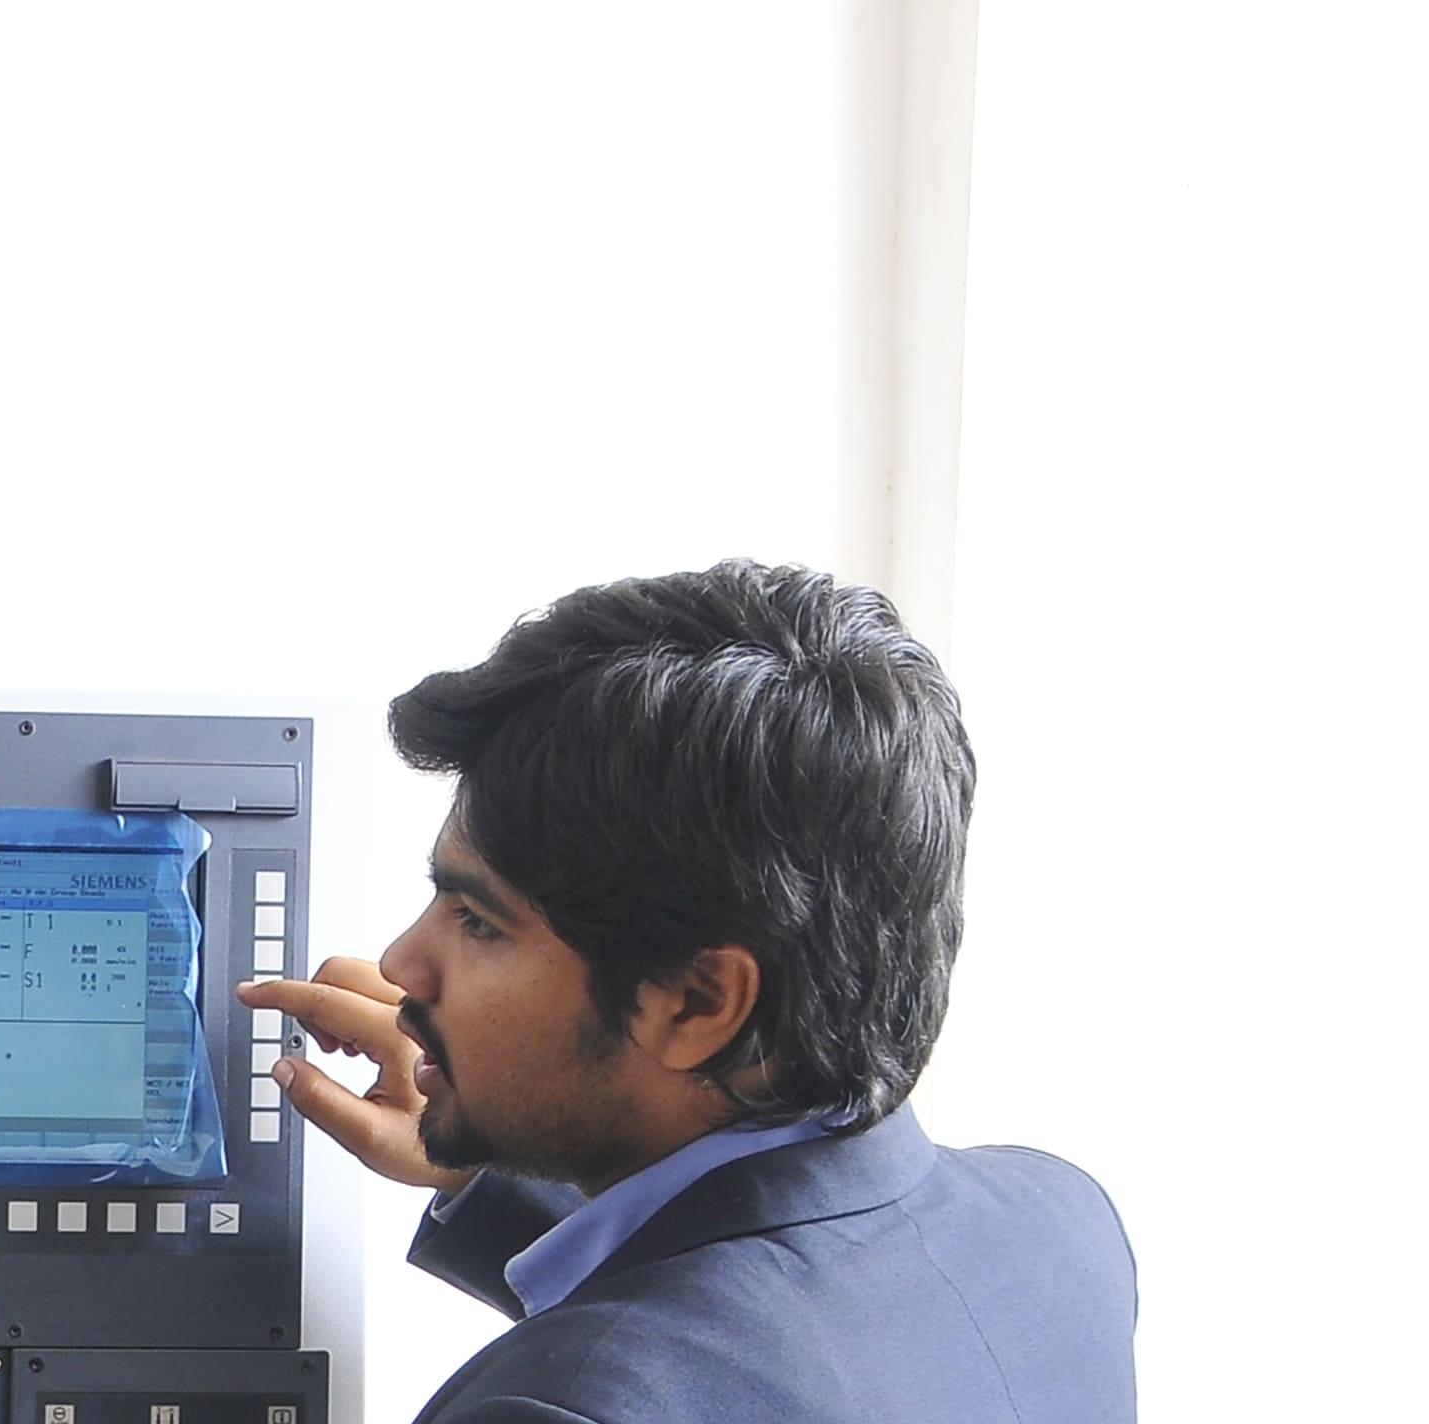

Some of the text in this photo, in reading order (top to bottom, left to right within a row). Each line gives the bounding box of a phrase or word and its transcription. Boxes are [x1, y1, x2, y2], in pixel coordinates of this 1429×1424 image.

[72, 876, 146, 888] SIEMENS
[27, 913, 52, 930] T 1
[25, 944, 33, 958] F
[25, 972, 41, 988] S1
